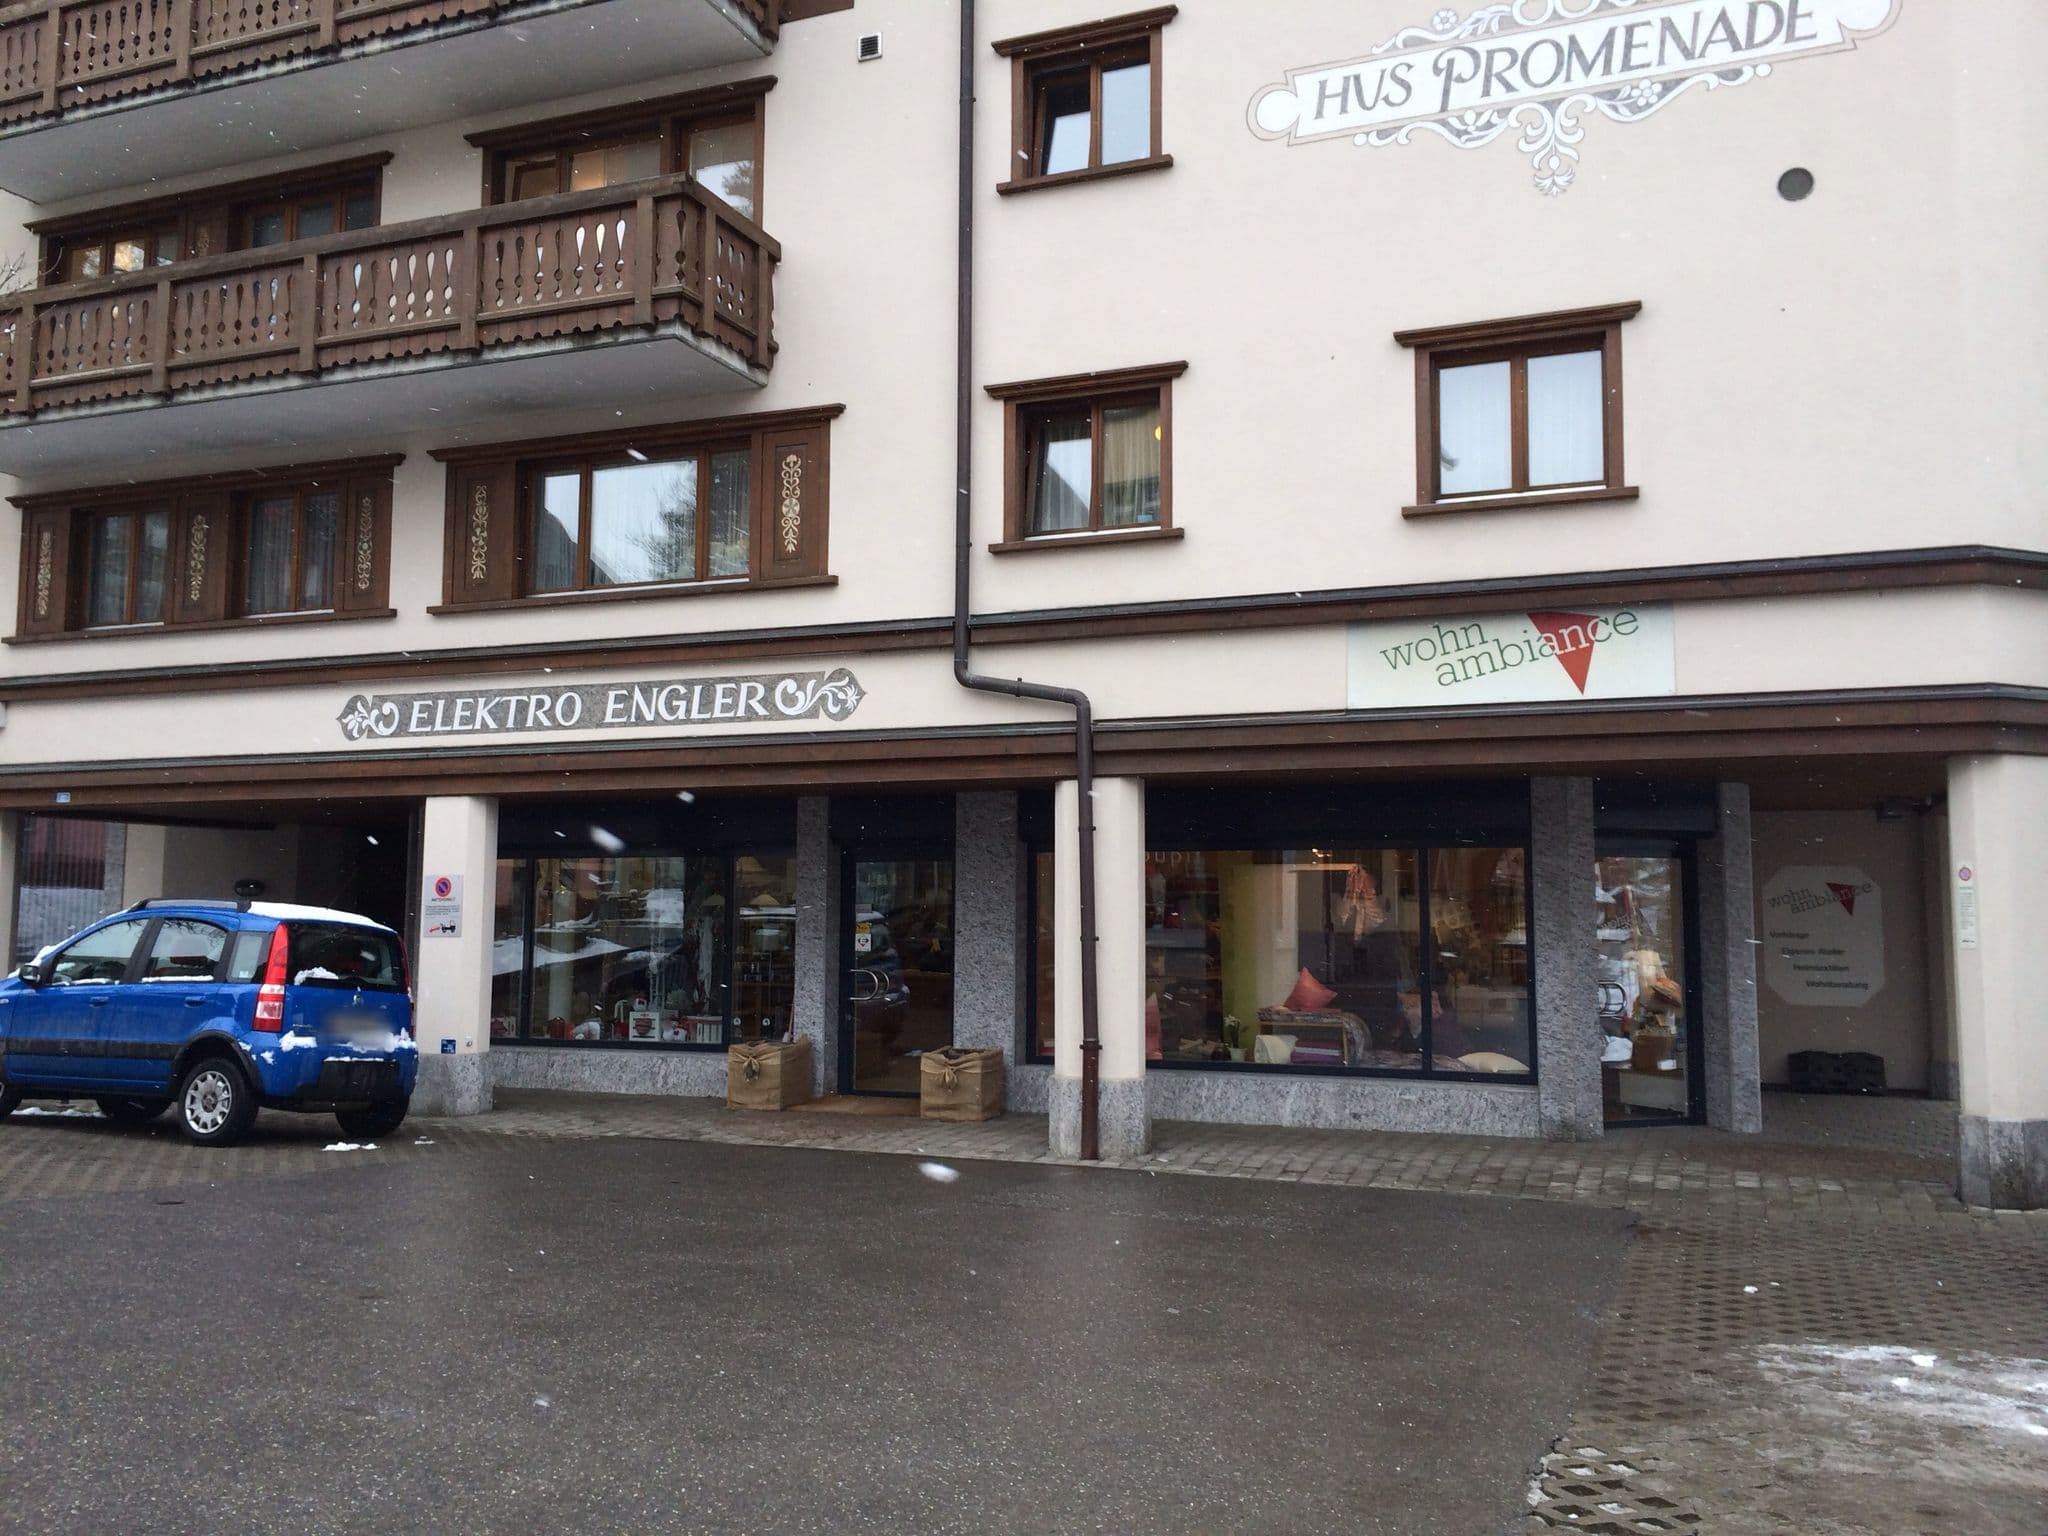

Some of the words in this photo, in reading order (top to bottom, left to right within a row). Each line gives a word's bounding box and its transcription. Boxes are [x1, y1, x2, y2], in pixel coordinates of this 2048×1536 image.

[1432, 0, 1818, 112] PROMENADE
[1380, 622, 1489, 670] wohn
[1435, 610, 1639, 687] ambiance
[408, 691, 583, 734] ELEKTRO
[603, 682, 769, 724] ENGLER
